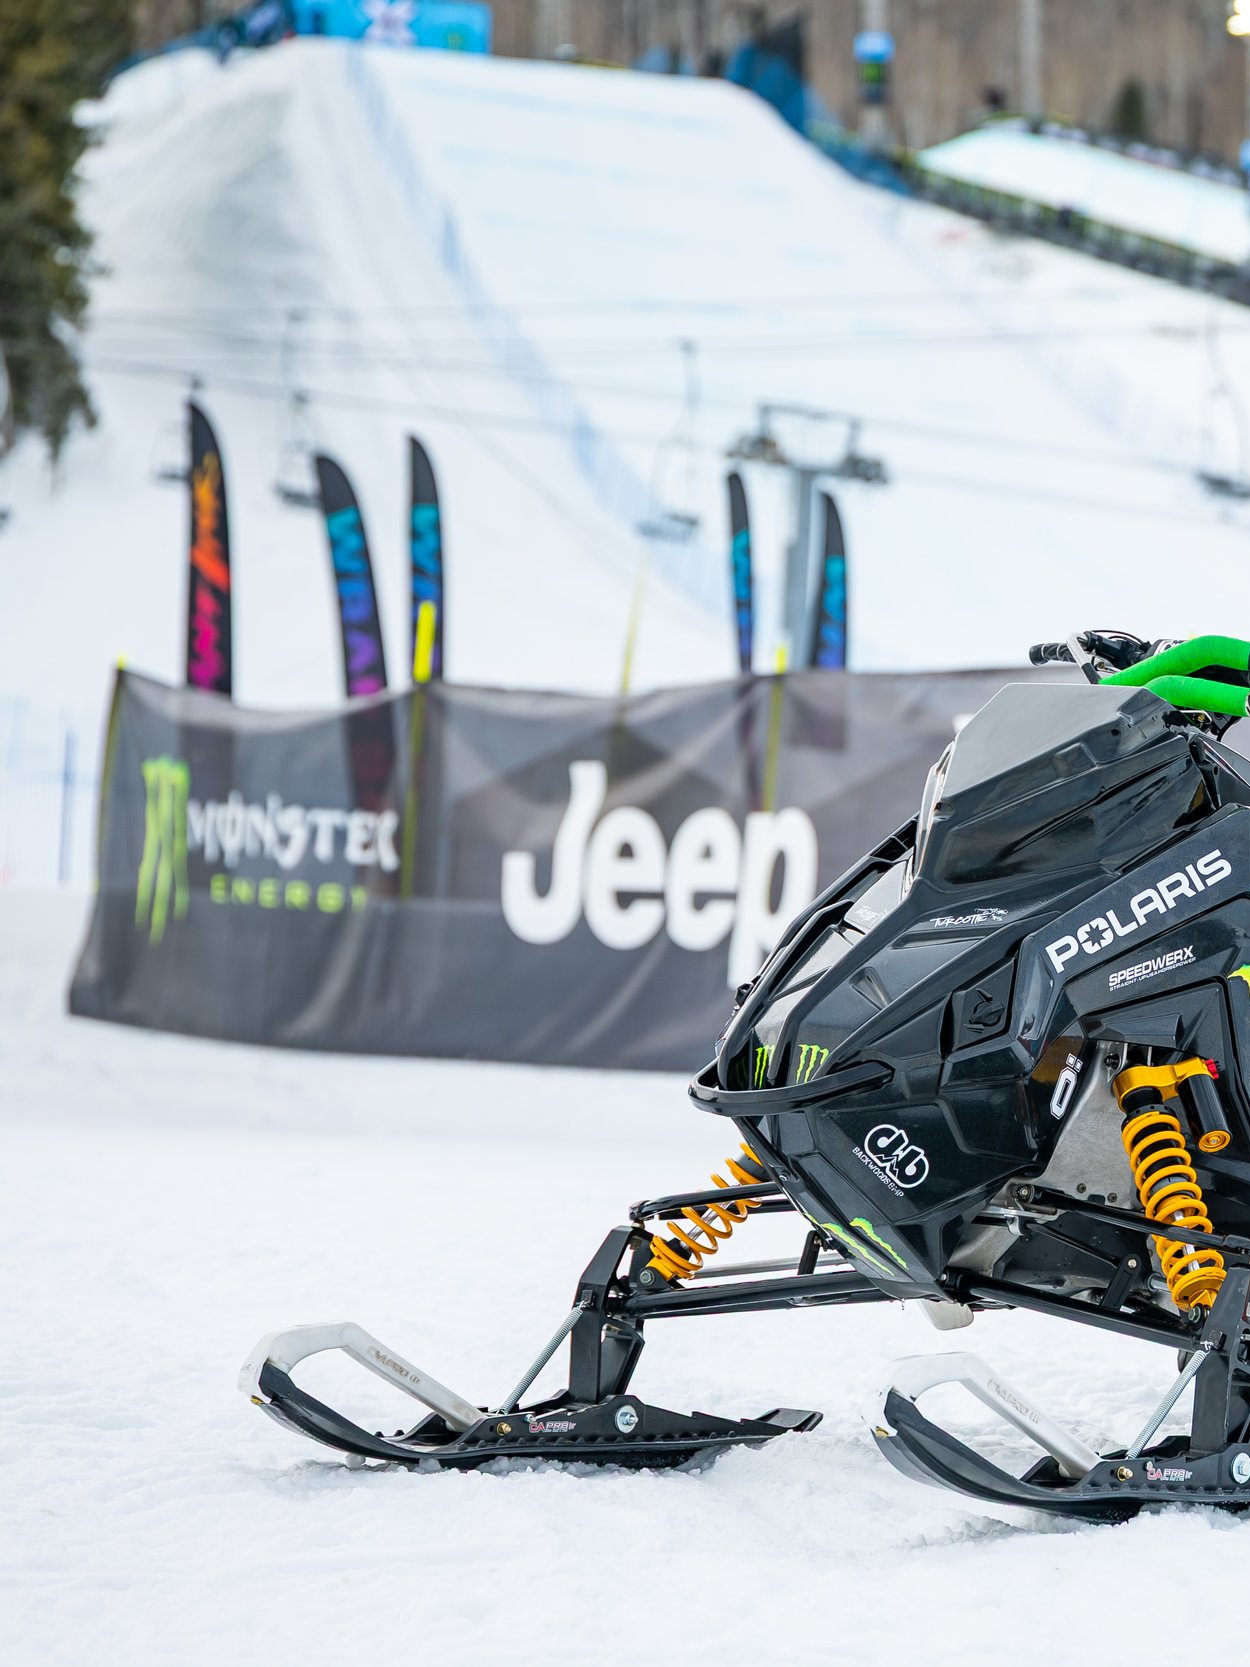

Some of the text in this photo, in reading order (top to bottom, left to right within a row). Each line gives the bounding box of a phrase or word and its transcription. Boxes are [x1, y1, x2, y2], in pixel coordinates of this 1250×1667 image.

[187, 788, 400, 874] MONSTER
[502, 760, 819, 991] Jeep
[1045, 849, 1232, 974] POLARIS
[1108, 944, 1194, 987] SPEEDWERX
[852, 1146, 892, 1185] BACKWOODS
